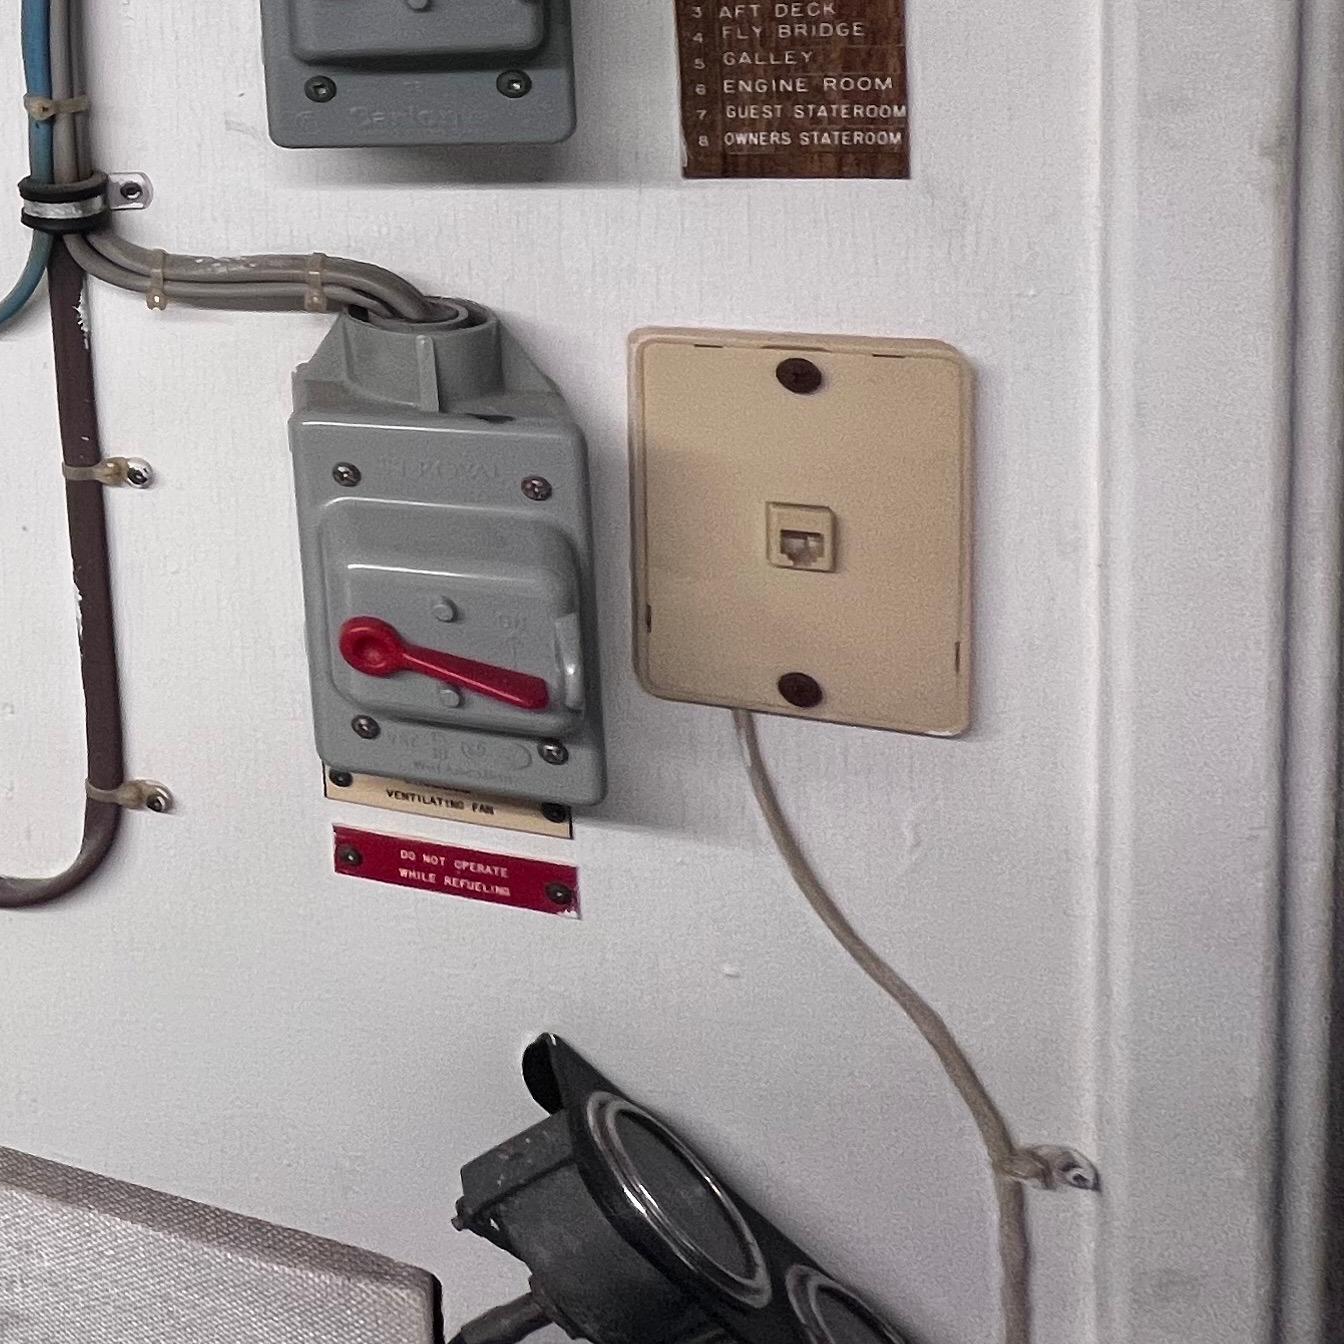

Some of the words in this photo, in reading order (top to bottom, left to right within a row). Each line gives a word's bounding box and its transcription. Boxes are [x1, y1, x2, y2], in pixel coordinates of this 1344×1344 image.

[691, 6, 702, 18] 3
[719, 5, 761, 18] AFT
[775, 2, 836, 18] DECK
[692, 32, 703, 43] 4
[722, 25, 763, 39] FLY
[778, 22, 865, 38] BRIDGE
[694, 58, 705, 69] 5
[723, 50, 813, 66] GALLEY
[695, 84, 706, 95] 6
[723, 78, 809, 93] ENGINE
[823, 76, 893, 91] ROOM
[696, 109, 707, 120] 7
[726, 105, 782, 119] GUEST
[794, 104, 906, 119] STATEROOM
[698, 135, 709, 147] 8
[724, 131, 792, 146] OWNERS
[799, 131, 902, 145] STATEROOM
[386, 788, 465, 810] VENTILATING
[472, 802, 495, 815] FAN
[400, 849, 416, 861] DO
[423, 853, 446, 866] NOT
[454, 859, 508, 878] OPERATE
[398, 867, 437, 884] WHILE
[443, 875, 511, 897] REFUELING
